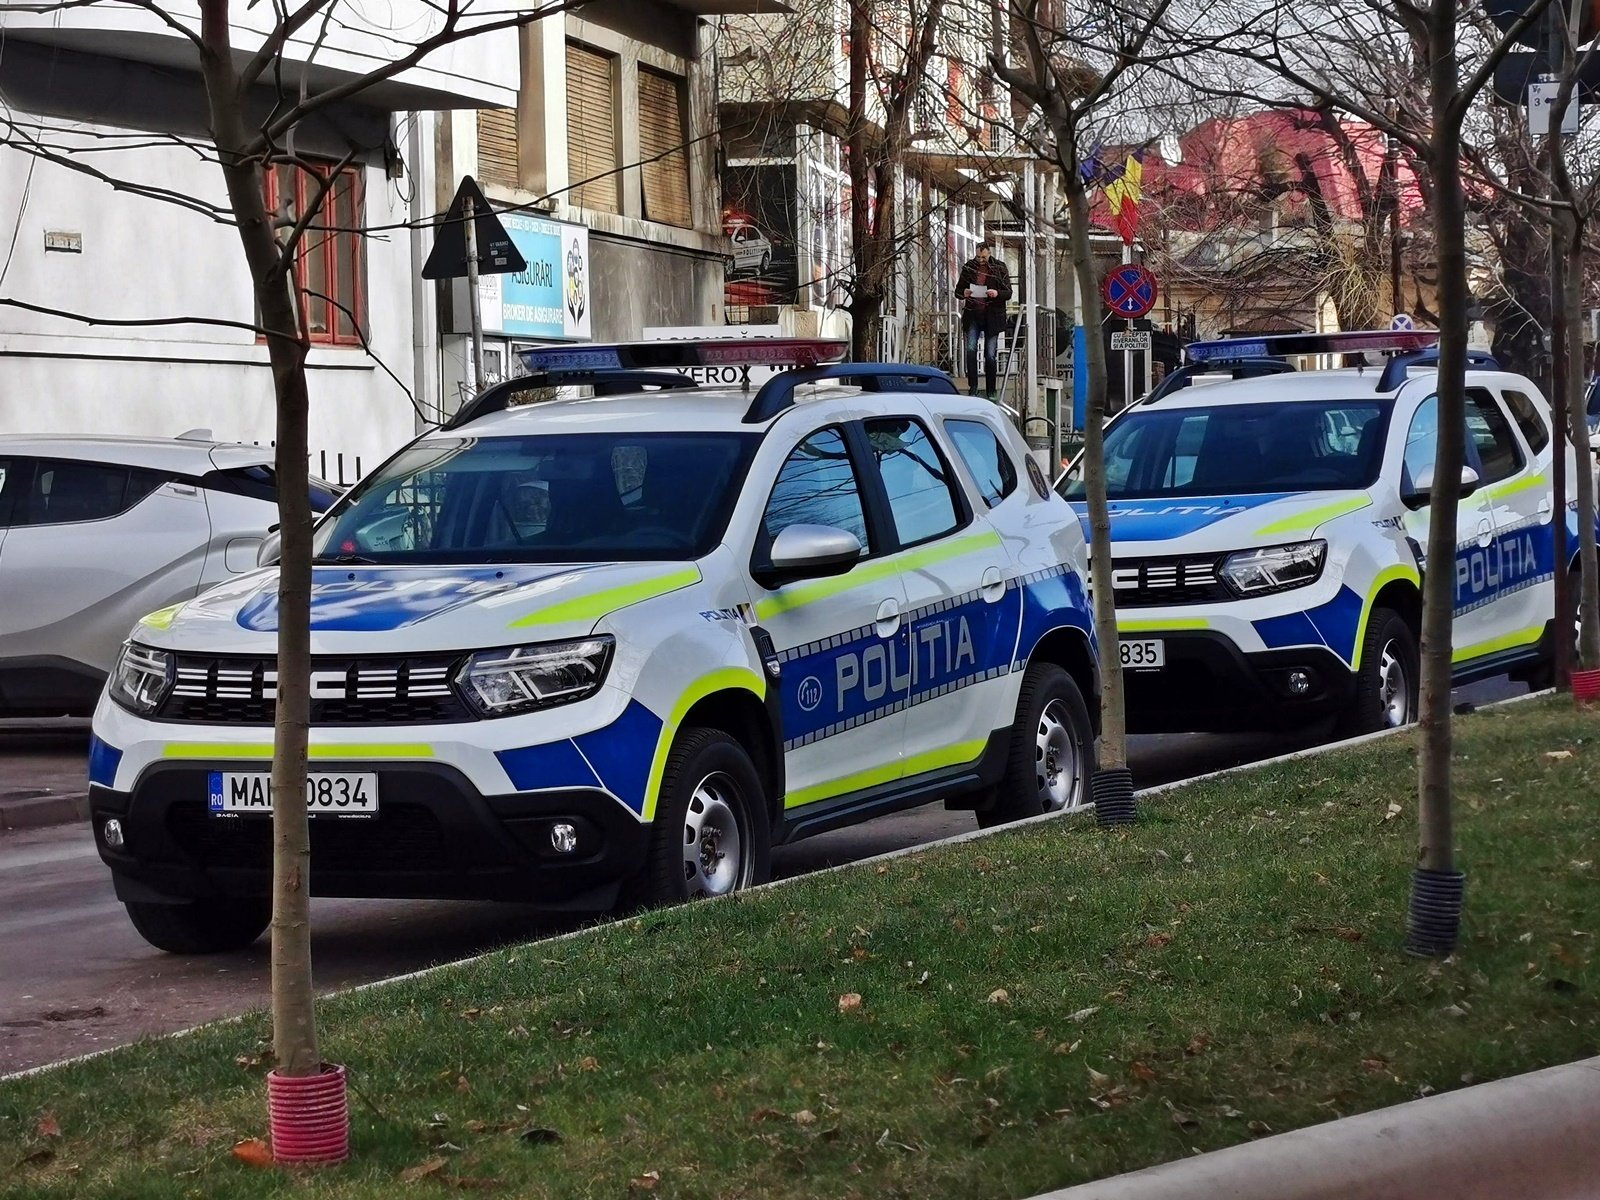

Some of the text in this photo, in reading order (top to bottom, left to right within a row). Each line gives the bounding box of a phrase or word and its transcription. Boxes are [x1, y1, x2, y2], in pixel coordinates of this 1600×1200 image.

[1534, 98, 1541, 107] 3
[503, 303, 563, 325] BROKER DE ASIGURARE
[1455, 533, 1537, 601] POLITIA
[312, 578, 518, 595] OLITIA
[805, 615, 976, 713] 112 POLITIA
[211, 794, 223, 806] RO
[231, 777, 272, 806] MAI
